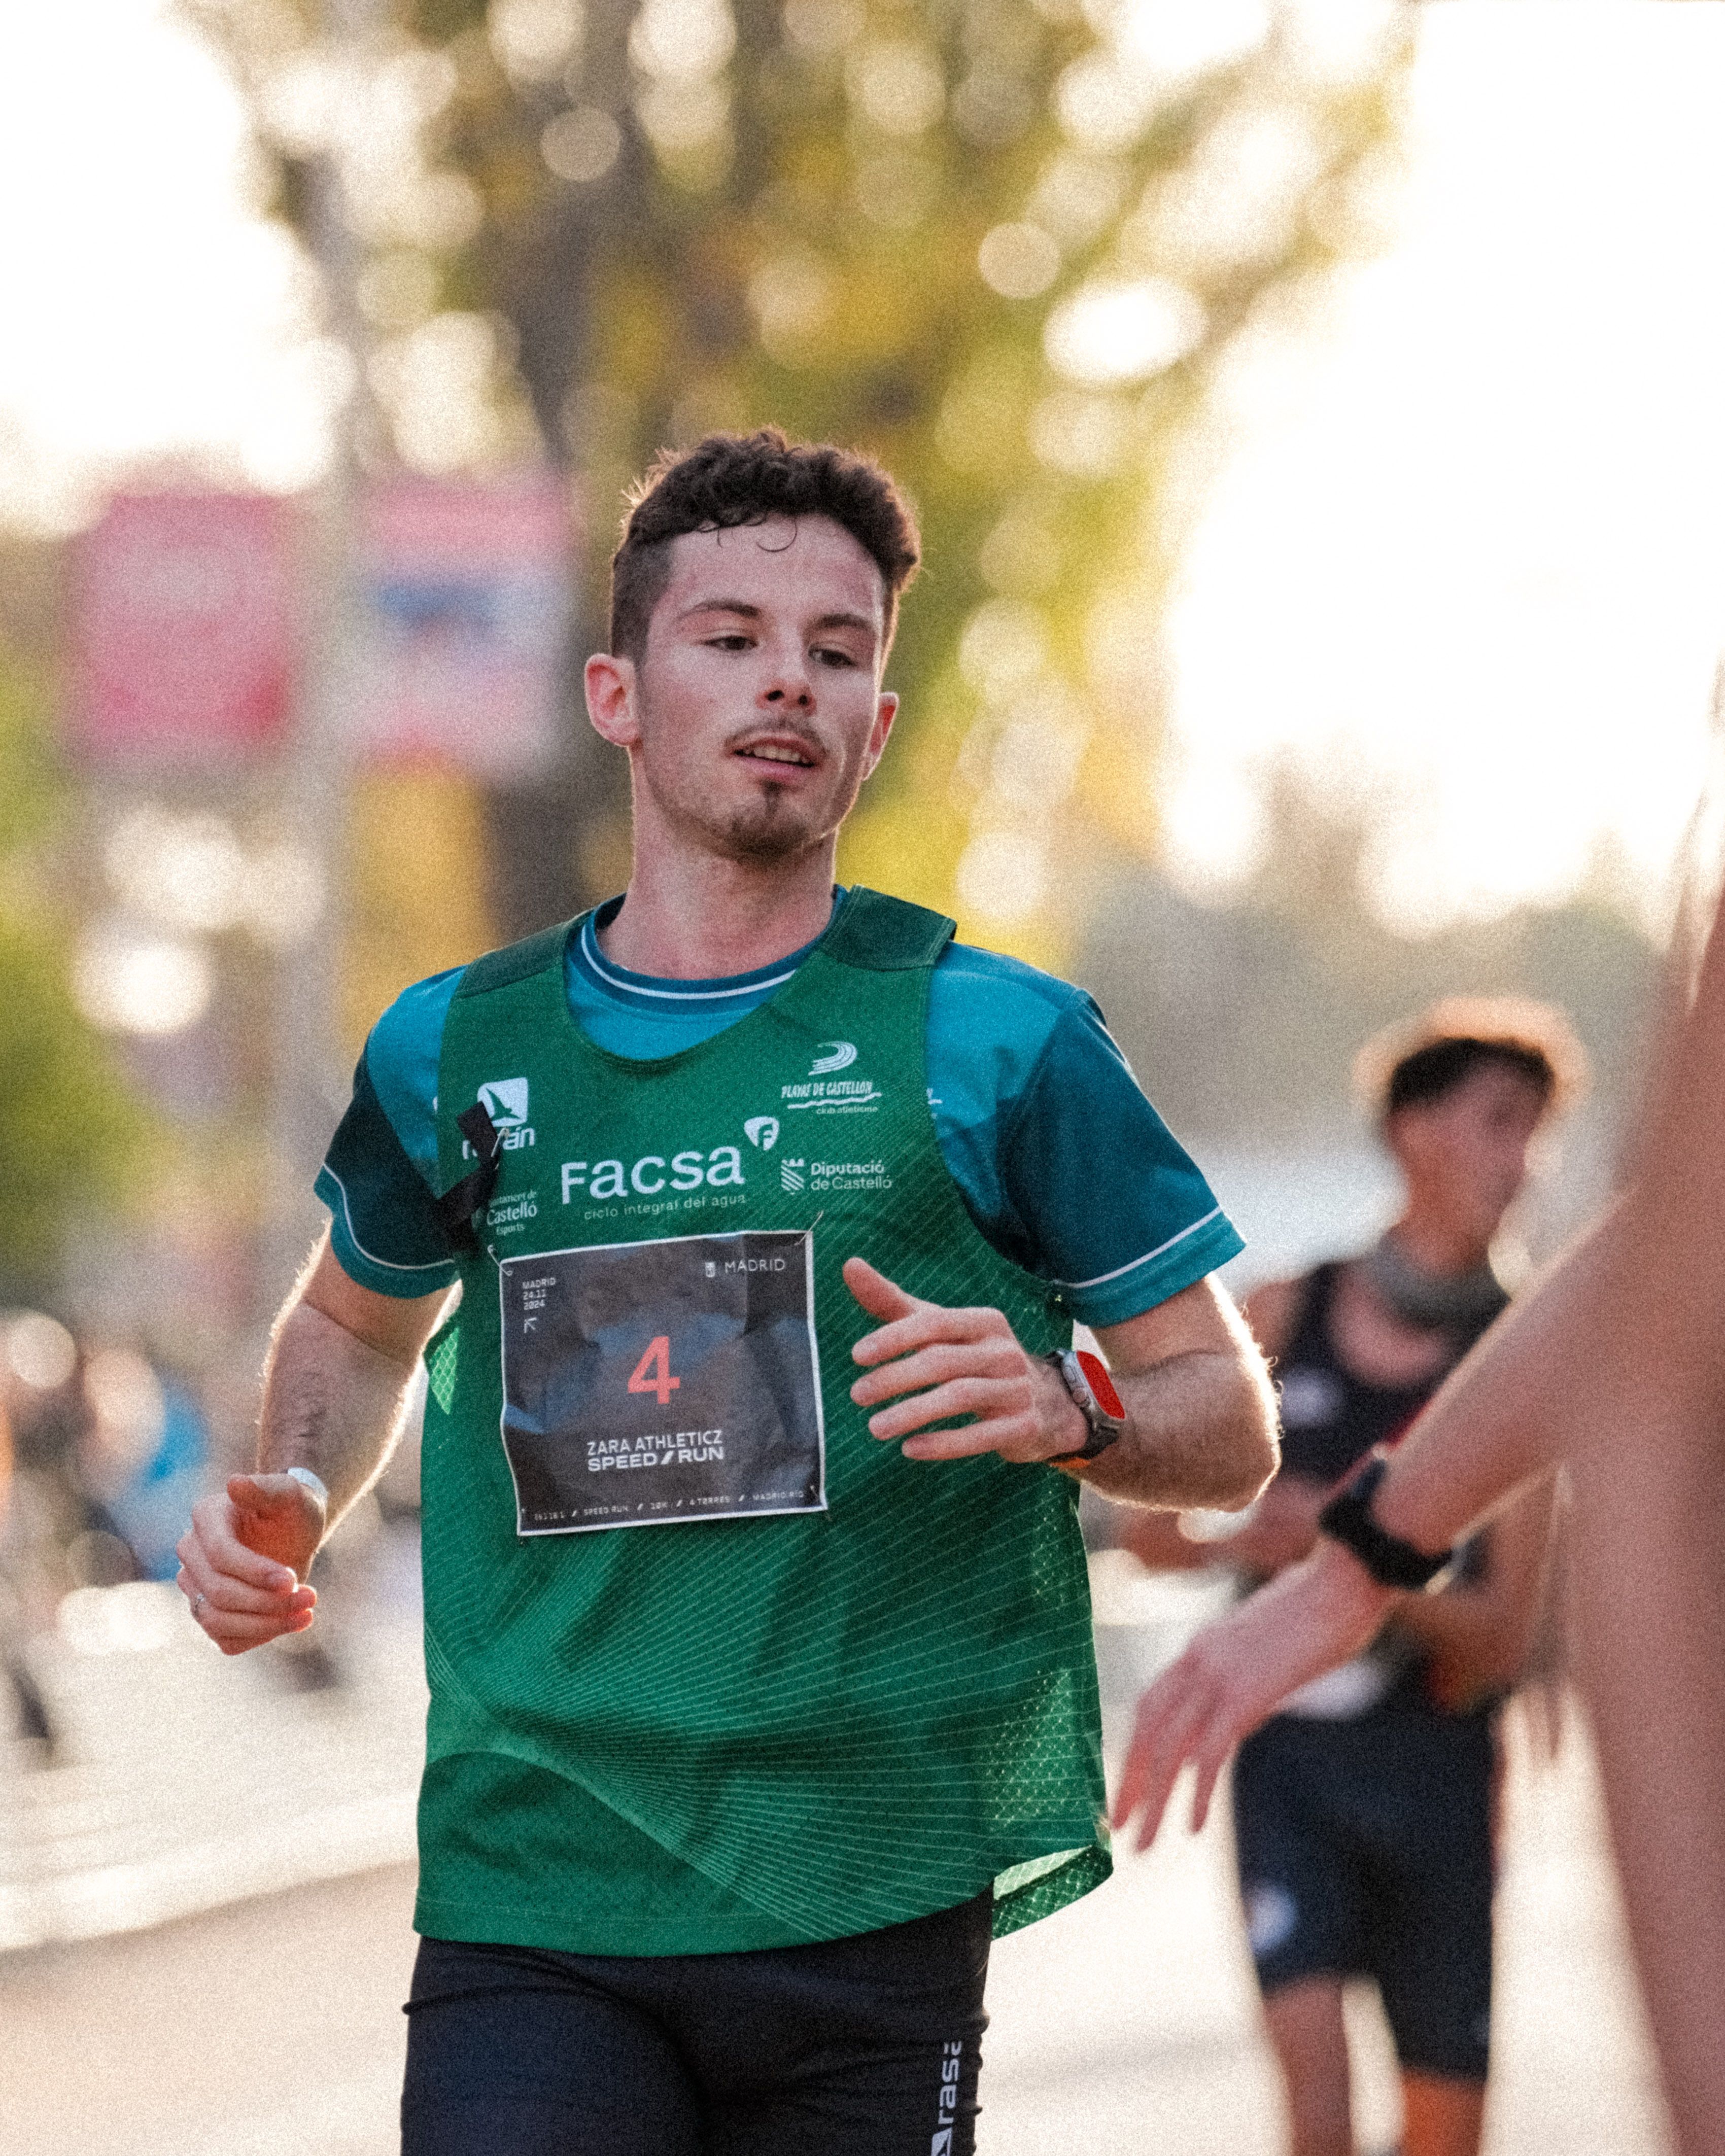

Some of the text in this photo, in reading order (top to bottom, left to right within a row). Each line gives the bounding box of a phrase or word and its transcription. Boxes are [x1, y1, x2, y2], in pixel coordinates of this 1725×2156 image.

[813, 1082, 825, 1096] DE
[561, 1146, 746, 1205] Facsa
[811, 1160, 885, 1177] Diputació
[811, 1175, 892, 1190] de Castelló
[487, 1201, 537, 1225] Castelló
[584, 1194, 746, 1220] ciclo integral del agua
[725, 1259, 785, 1274] MADRID
[523, 1277, 556, 1289] MADRID
[524, 1300, 545, 1310] 2024
[628, 1336, 680, 1404] 4
[587, 1430, 723, 1456] ZARA ATHLETICZ
[584, 1506, 609, 1516] SPEED
[611, 1505, 629, 1513] RUN
[698, 1496, 731, 1505] TORRES
[752, 1491, 786, 1501] MADRID
